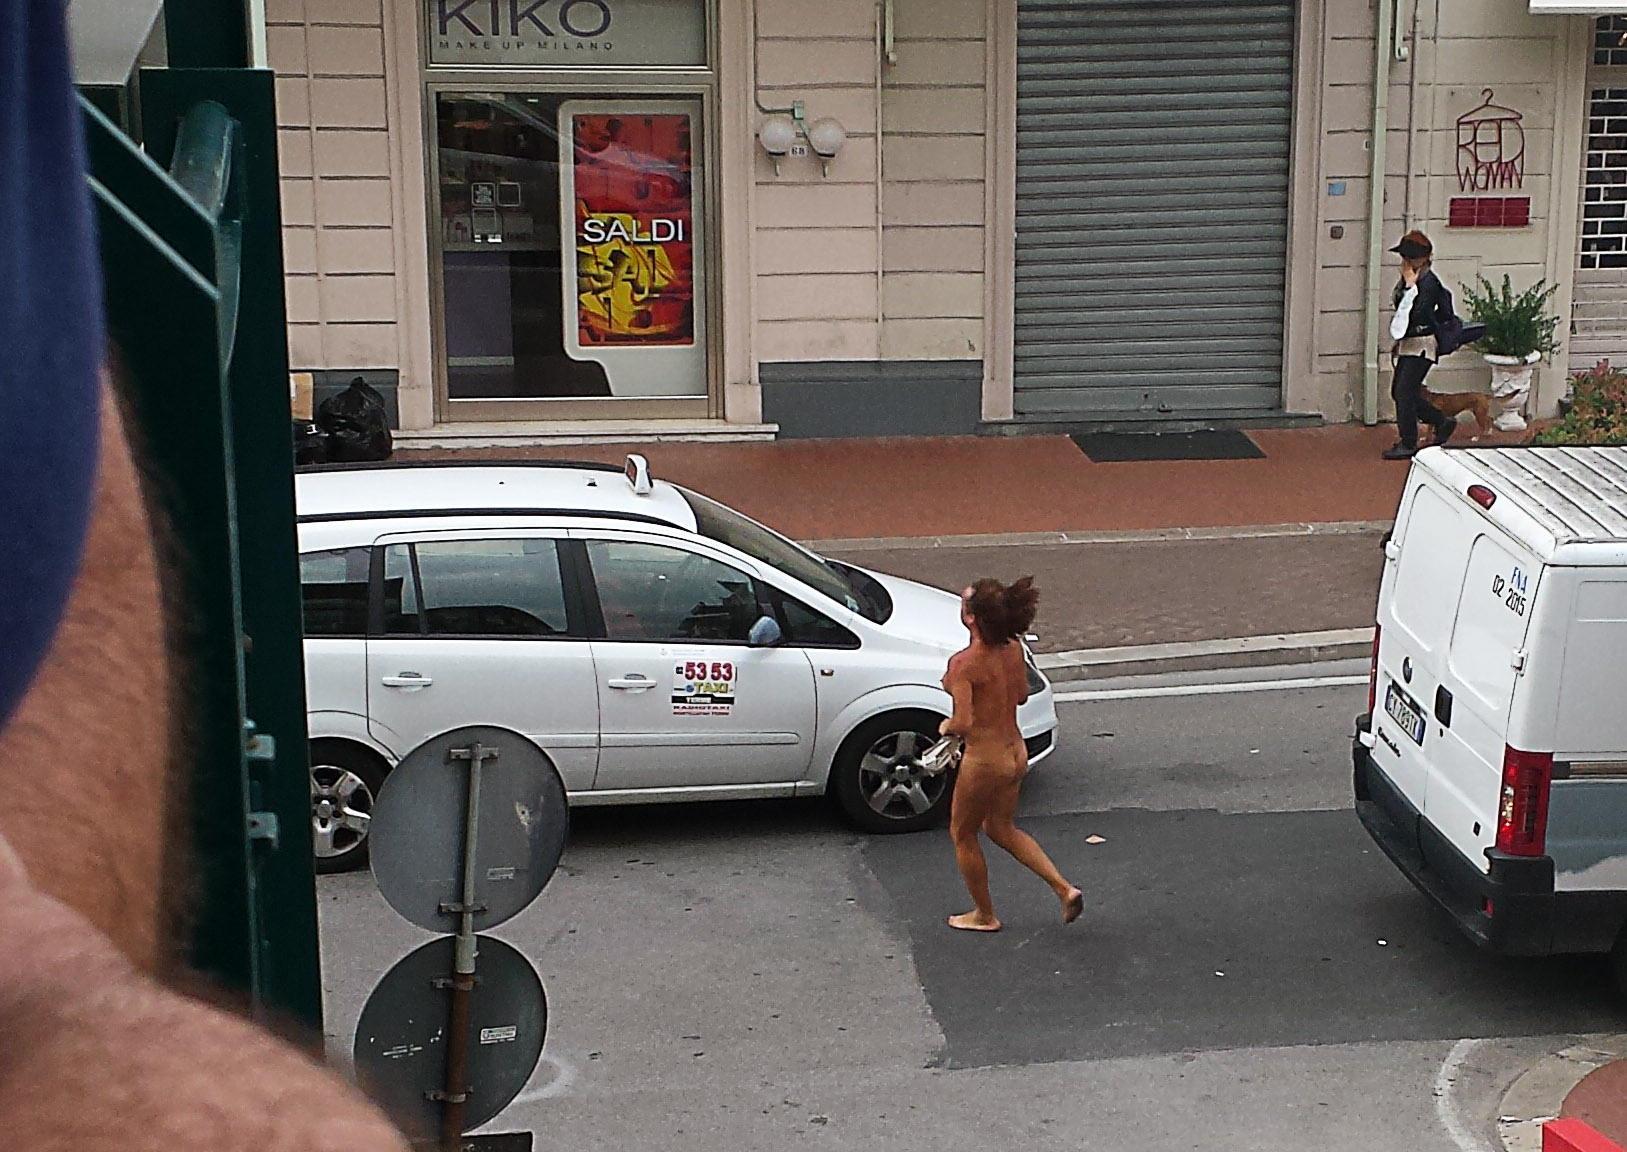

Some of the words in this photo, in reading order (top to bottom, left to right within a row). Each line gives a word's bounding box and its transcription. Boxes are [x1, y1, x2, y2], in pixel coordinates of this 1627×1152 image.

[437, 0, 612, 37] KIKO
[439, 41, 491, 50] MAKE
[502, 41, 525, 50] UP
[538, 41, 614, 50] MILANO
[1457, 161, 1524, 192] WOMAN
[583, 218, 684, 243] SALDI
[1505, 588, 1527, 616] 2015
[685, 661, 707, 681] 53
[711, 662, 733, 681] 53
[694, 682, 729, 693] TAXI
